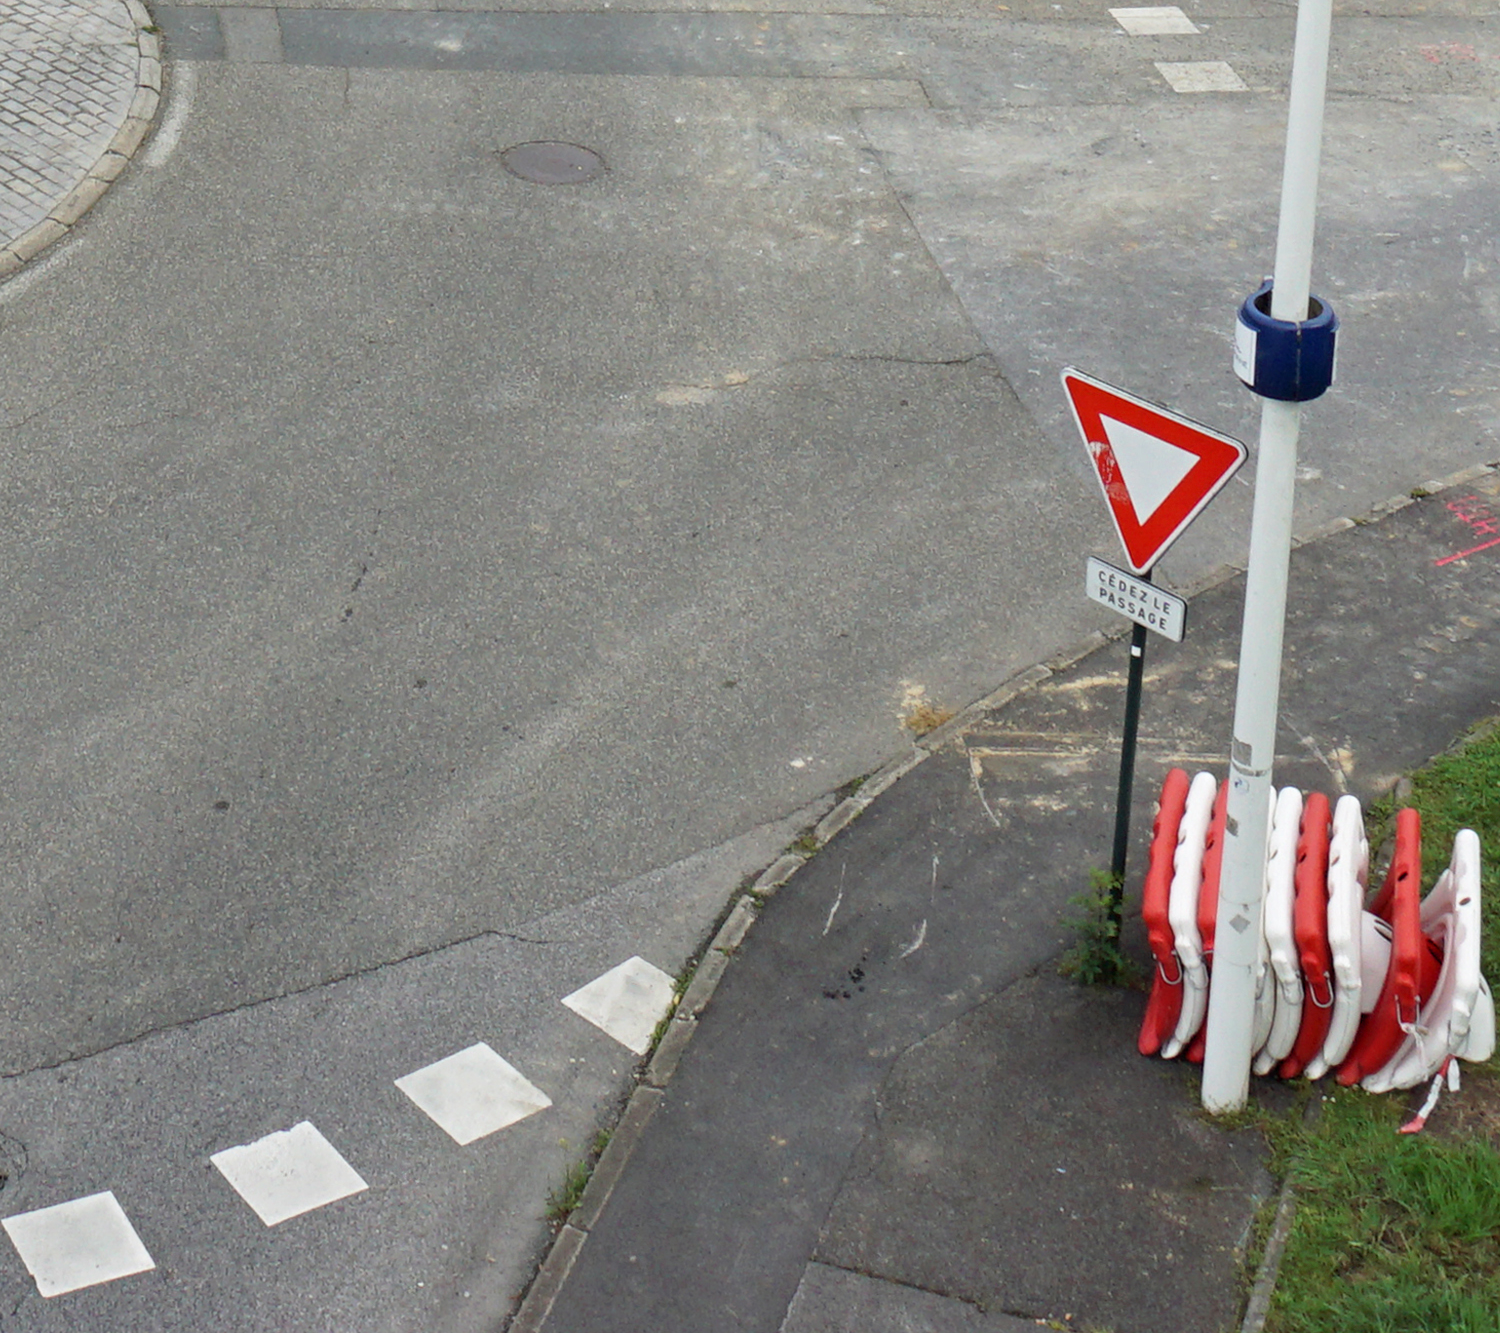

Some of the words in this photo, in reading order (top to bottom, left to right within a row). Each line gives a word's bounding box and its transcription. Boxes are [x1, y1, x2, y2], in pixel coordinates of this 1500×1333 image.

[1098, 570, 1148, 604] CÉDEZ
[1153, 597, 1171, 615] LE
[1099, 587, 1167, 631] PASSAGE
